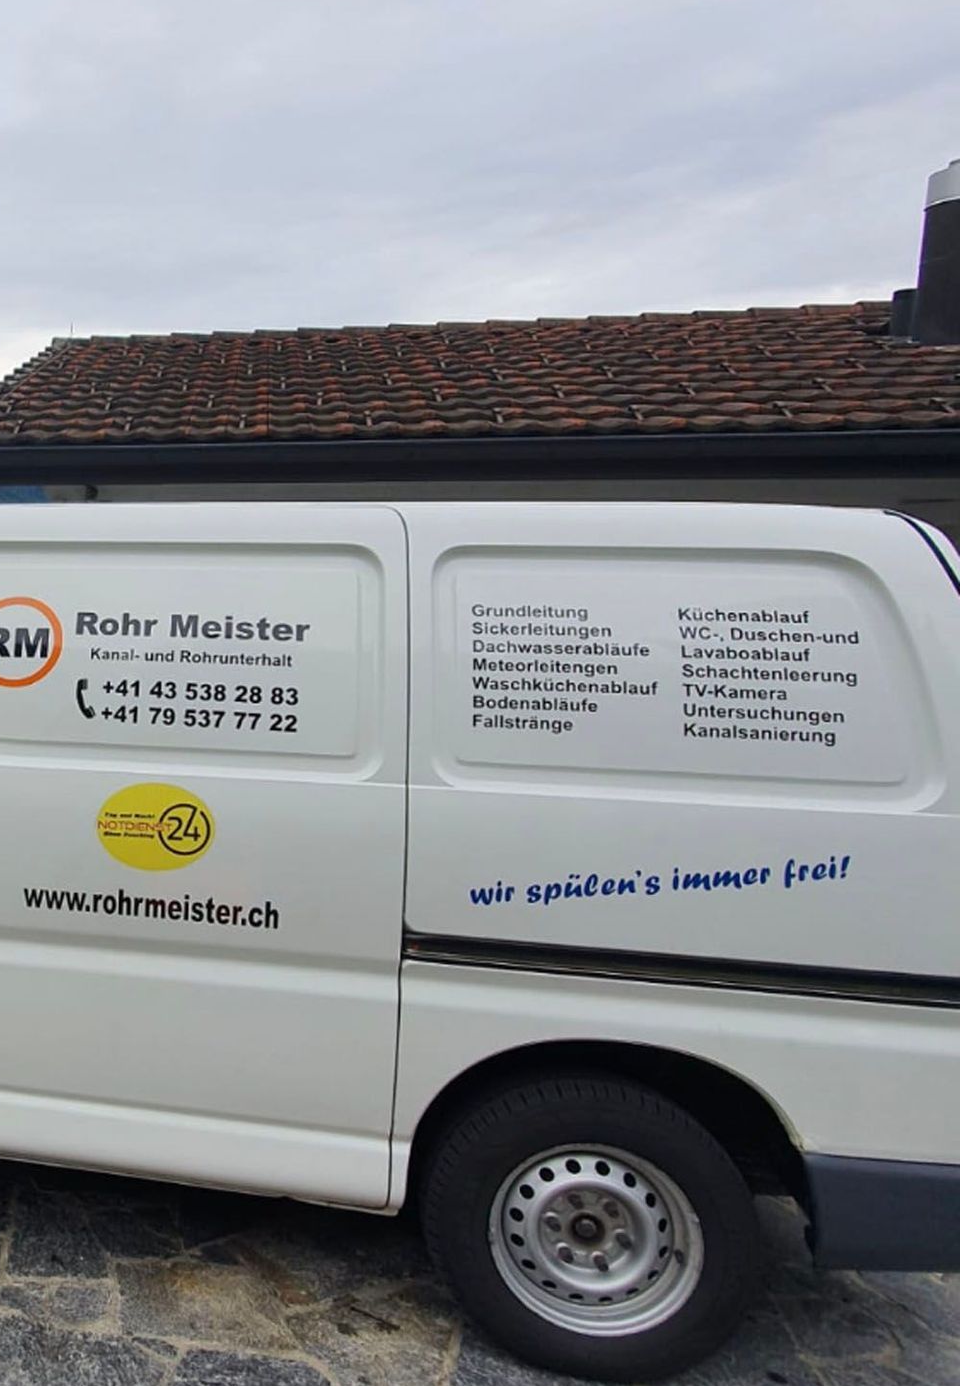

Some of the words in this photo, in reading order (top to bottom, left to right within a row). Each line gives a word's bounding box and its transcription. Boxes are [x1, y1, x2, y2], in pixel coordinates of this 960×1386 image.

[471, 603, 589, 622] Grundleitung
[677, 607, 810, 624] Küchenablauf
[75, 611, 159, 637] Rohr
[169, 613, 311, 642] Meister
[471, 621, 612, 640] Sickerleitungen
[90, 647, 140, 661] Kanal-
[144, 650, 175, 663] und
[179, 650, 293, 668] Rohrunterhalt
[472, 639, 651, 657] Dachwasserabläufe
[680, 645, 811, 662] Lavaboablauf
[472, 657, 619, 677] Meteorleitengen
[681, 663, 858, 687] Schachtenleerung
[103, 679, 141, 698] +41
[149, 680, 177, 700] 43
[184, 682, 227, 702] 538
[234, 685, 263, 704] 28
[270, 687, 299, 706] 83
[472, 675, 659, 696] Waschküchenablauf
[682, 683, 788, 701] TV-Kamera
[472, 694, 599, 713] Bodenabläufe
[683, 702, 845, 726] Untersuchungen
[101, 705, 139, 724] +41
[148, 706, 176, 726] 79
[183, 708, 226, 728] 537
[233, 710, 262, 730] 77
[269, 713, 298, 733] 22
[472, 713, 574, 734] Fallstränge
[683, 722, 837, 747] Kanalsanierung
[97, 819, 172, 832] NOTDIENST
[469, 880, 516, 906] wir
[672, 867, 771, 892] immer
[783, 855, 852, 889] frei!
[23, 887, 280, 930] www.rohrmeister.ch
